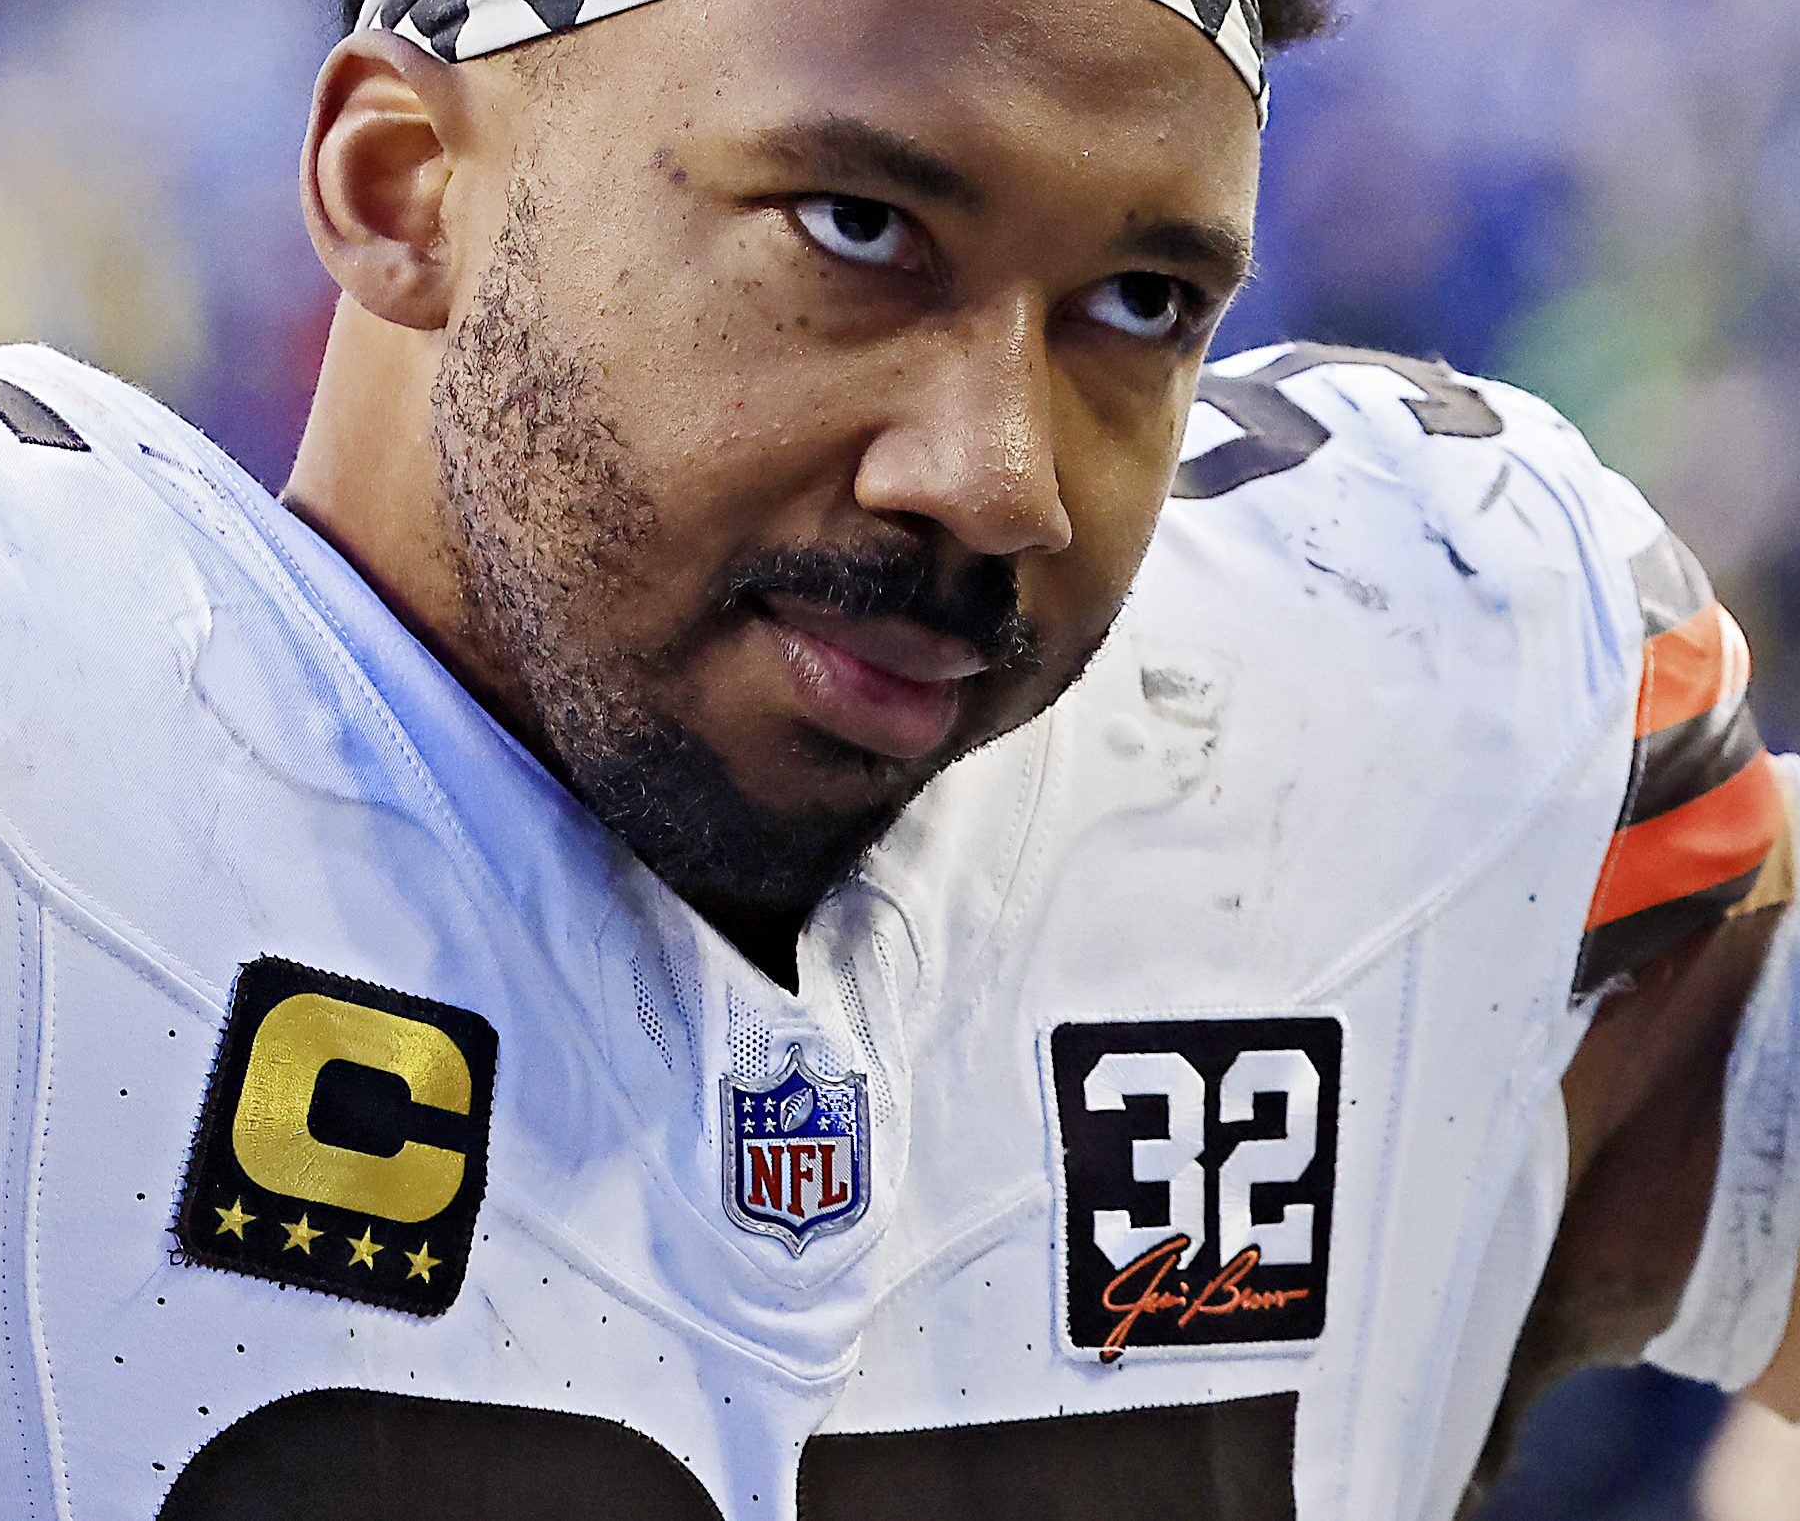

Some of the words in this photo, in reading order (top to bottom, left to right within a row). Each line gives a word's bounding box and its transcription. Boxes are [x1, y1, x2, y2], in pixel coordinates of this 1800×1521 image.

[232, 992, 472, 1224] C
[747, 1143, 850, 1220] NFL
[1082, 1048, 1321, 1272] 32
